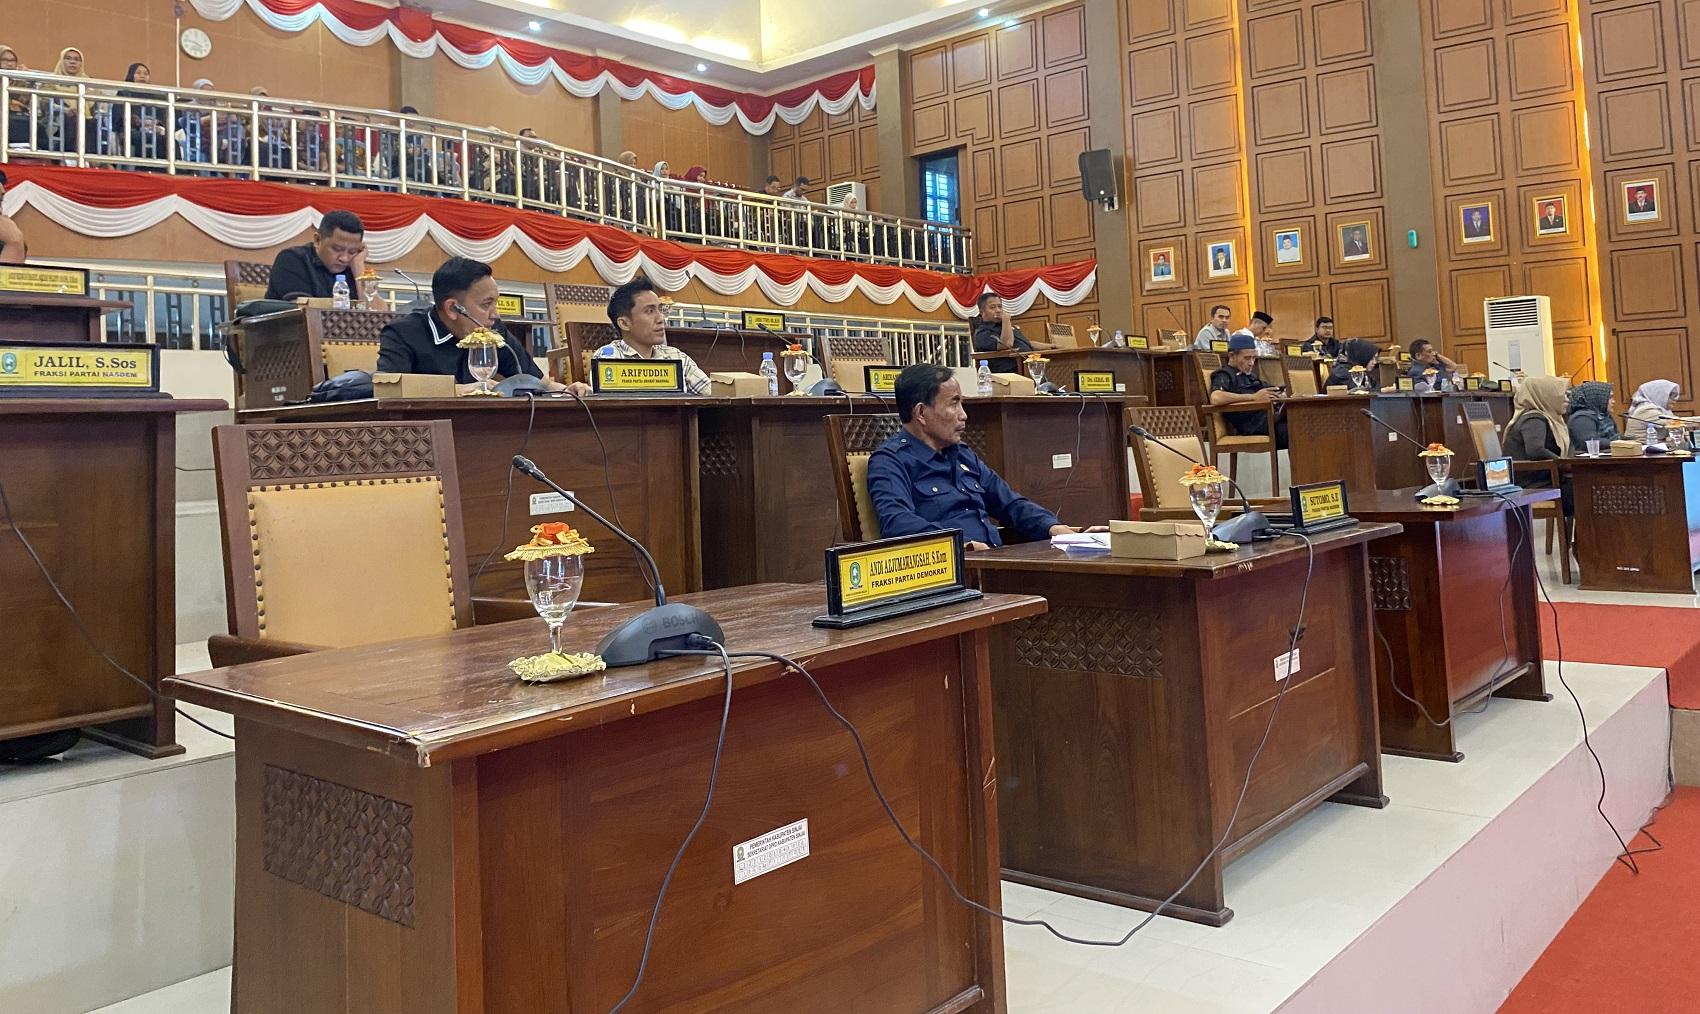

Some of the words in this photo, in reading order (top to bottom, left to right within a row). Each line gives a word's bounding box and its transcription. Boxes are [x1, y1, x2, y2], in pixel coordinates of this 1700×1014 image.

[34, 356, 89, 369] JALIL,
[95, 357, 137, 369] S.Sos
[621, 369, 669, 377] ARIFUDDIN
[870, 560, 884, 576] ANDI
[871, 577, 894, 588] FRAKSI
[895, 573, 916, 584] PARTAI
[916, 567, 948, 580] DEMOKRAT
[662, 615, 699, 628] BOSCH
